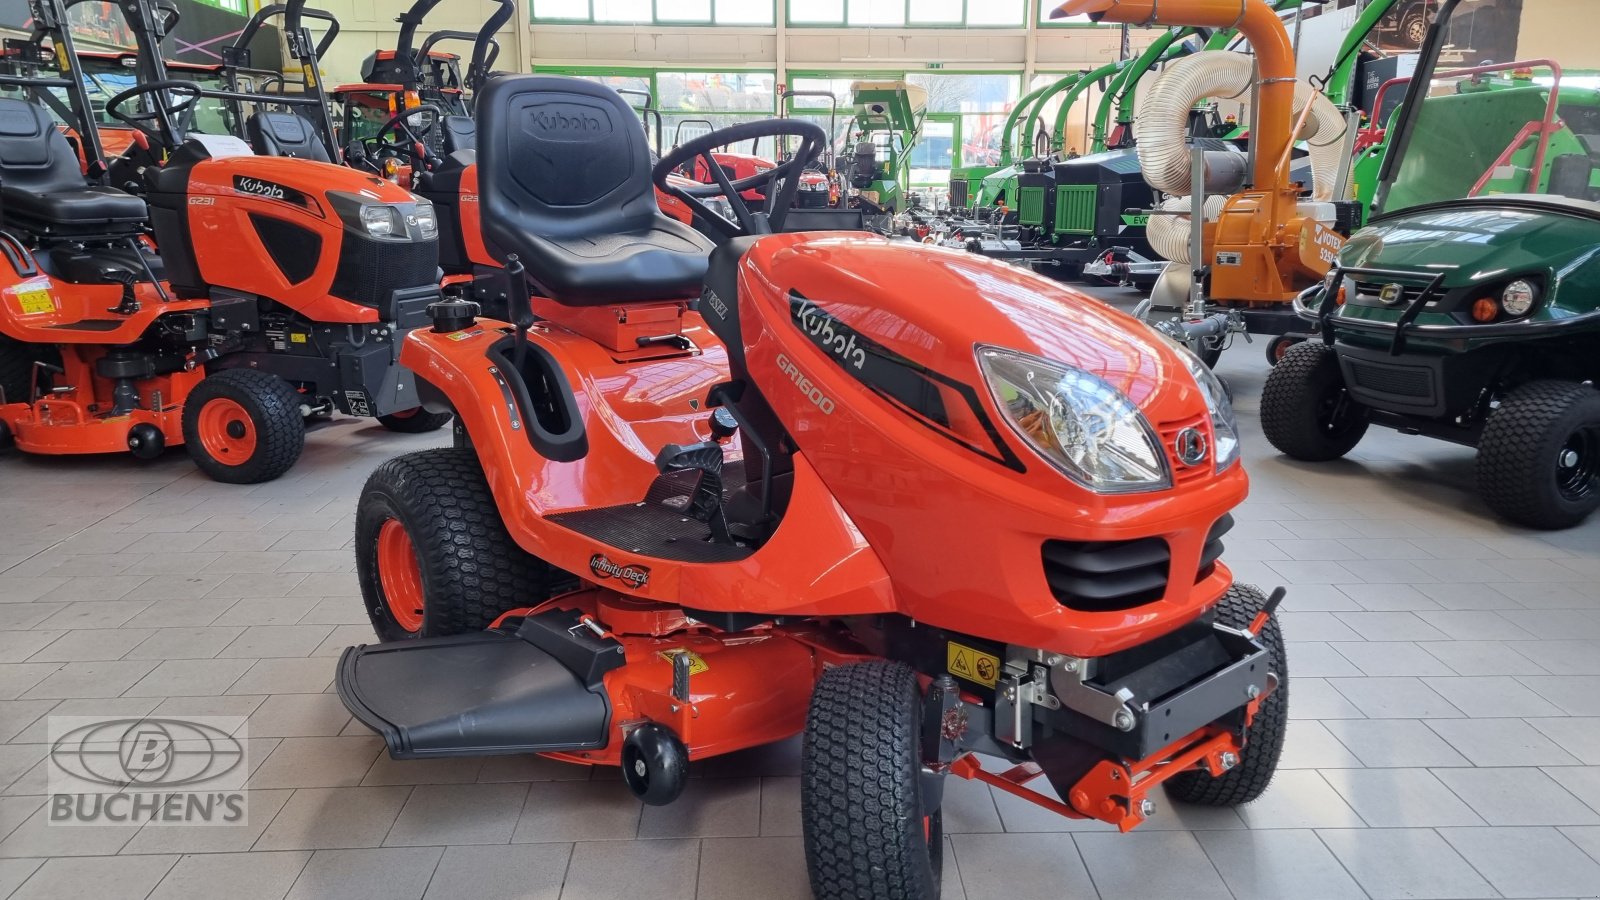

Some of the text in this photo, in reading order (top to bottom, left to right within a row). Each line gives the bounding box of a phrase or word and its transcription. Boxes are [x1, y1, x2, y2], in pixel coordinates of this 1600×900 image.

[530, 111, 601, 132] Kubota
[239, 176, 285, 199] Kubota
[460, 194, 479, 202] G23
[188, 196, 216, 206] G231
[796, 300, 866, 370] Kubota
[776, 353, 836, 415] GR1600
[623, 567, 649, 583] Deck
